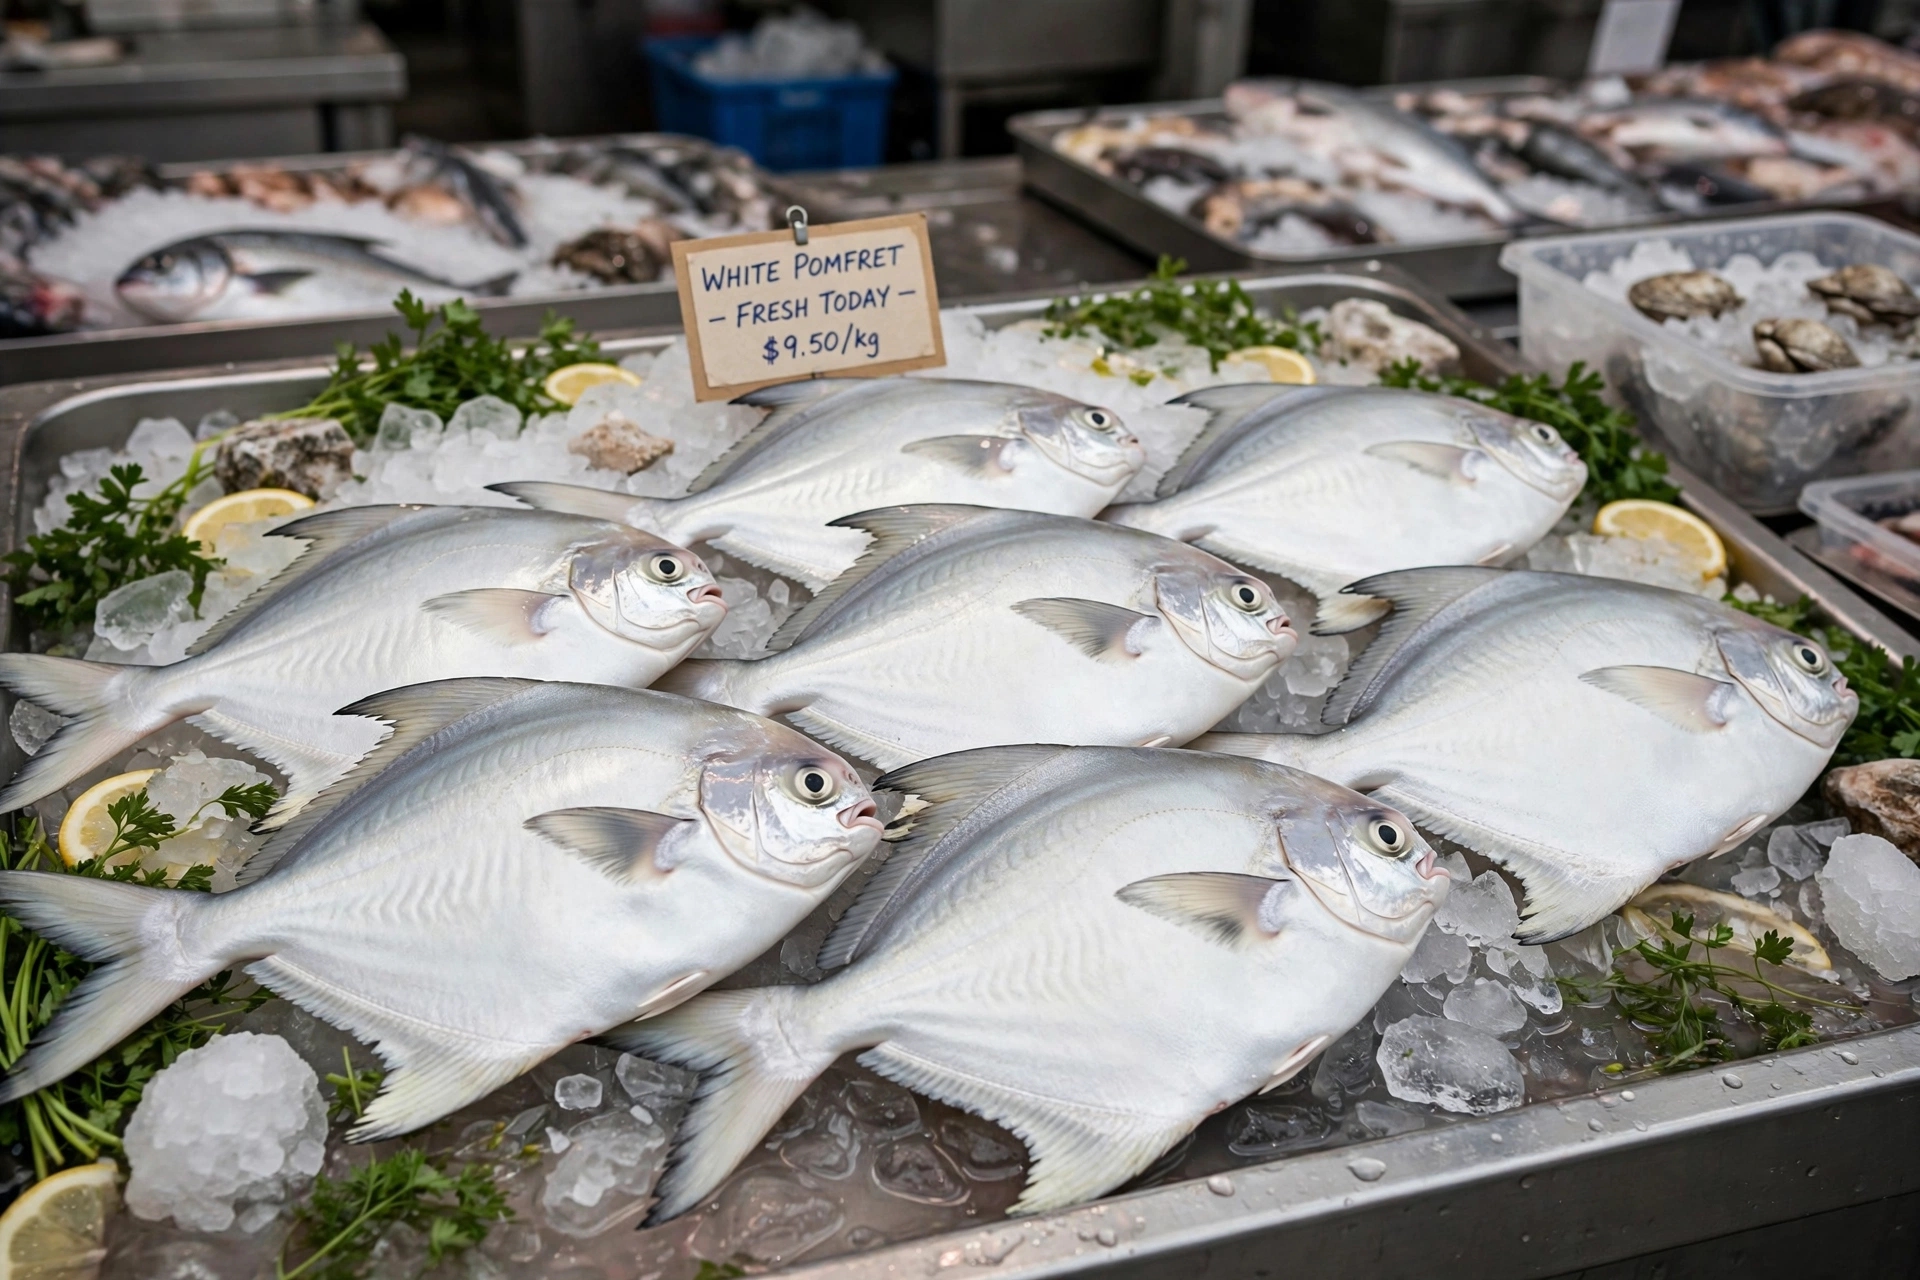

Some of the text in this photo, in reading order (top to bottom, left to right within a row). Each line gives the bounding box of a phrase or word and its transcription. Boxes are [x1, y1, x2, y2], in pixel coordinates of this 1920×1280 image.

[702, 244, 904, 292] WHITE POMFRET
[737, 297, 808, 328] FRESH
[819, 285, 890, 315] TODAY
[762, 323, 880, 365] $9.50/kg
